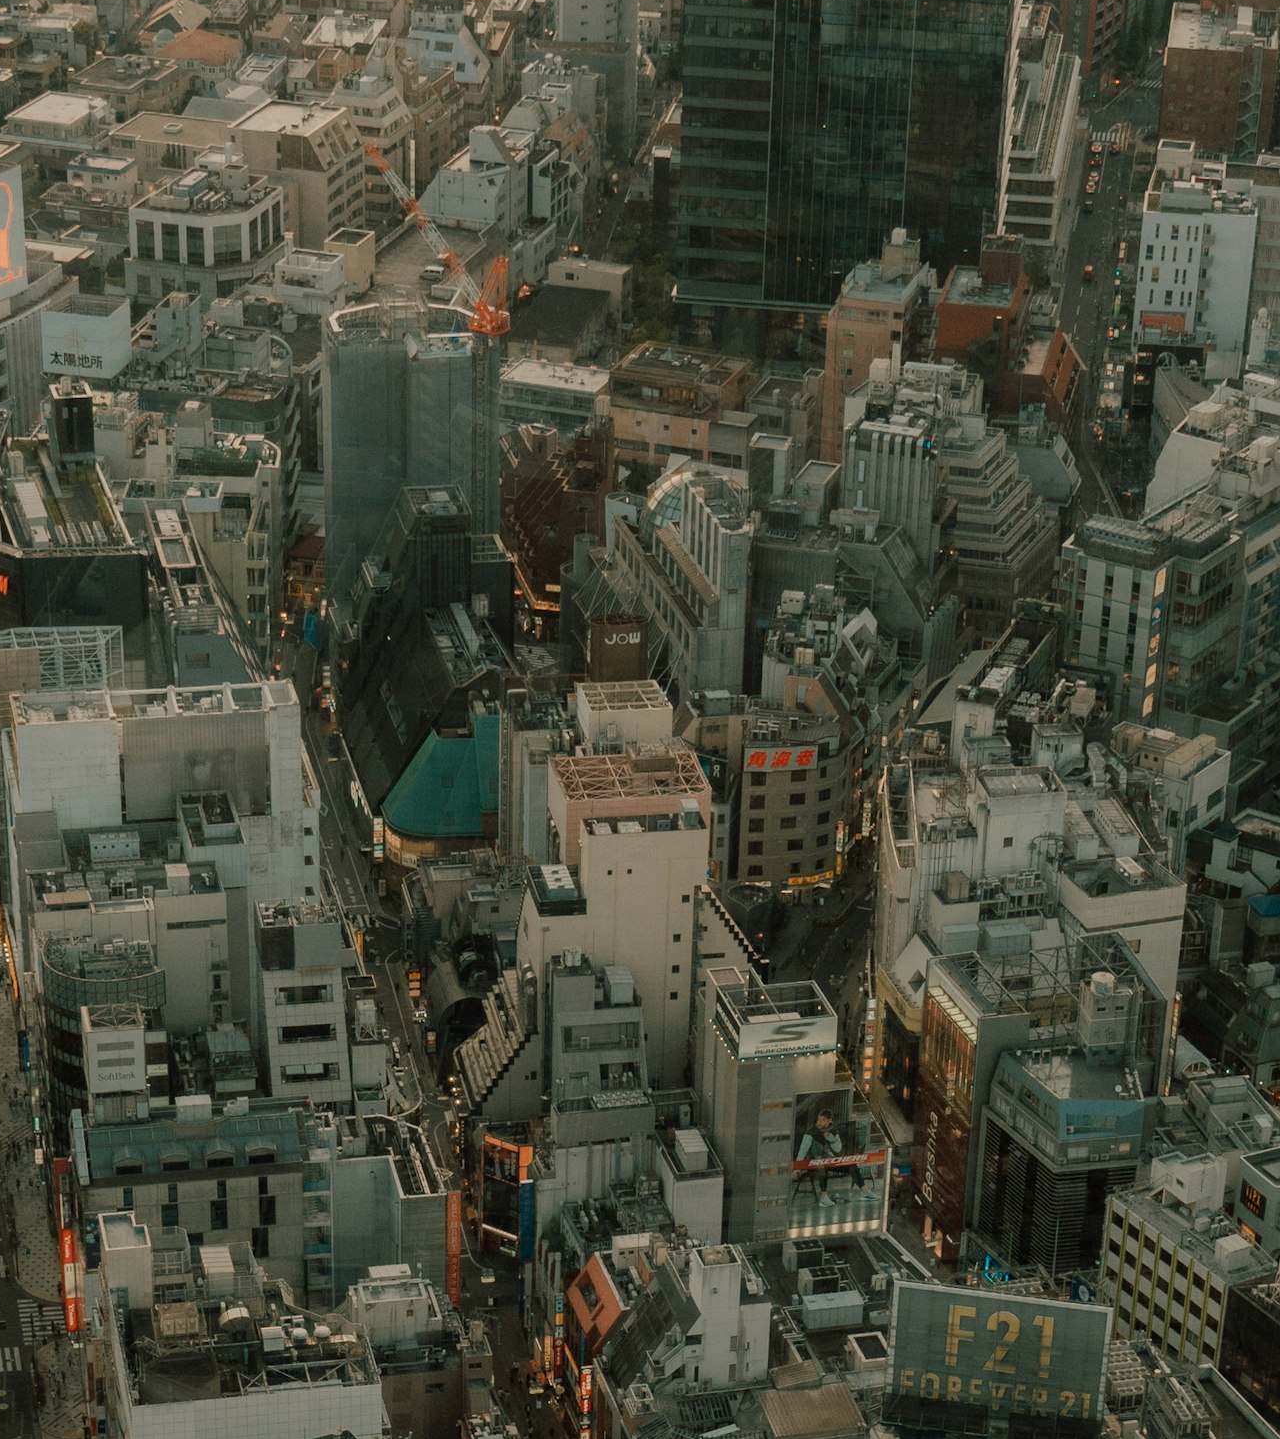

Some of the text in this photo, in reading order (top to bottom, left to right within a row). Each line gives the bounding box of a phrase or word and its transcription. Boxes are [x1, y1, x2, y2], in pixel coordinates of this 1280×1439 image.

[49, 352, 103, 371] 太陽地所
[754, 1044, 819, 1055] PERFORMANCE
[98, 1072, 136, 1082] SoftBank
[809, 1155, 868, 1167] SKECHERS
[922, 1111, 938, 1203] Bershka
[943, 1304, 1056, 1379] F21
[899, 1369, 1094, 1419] FOREVER 21
